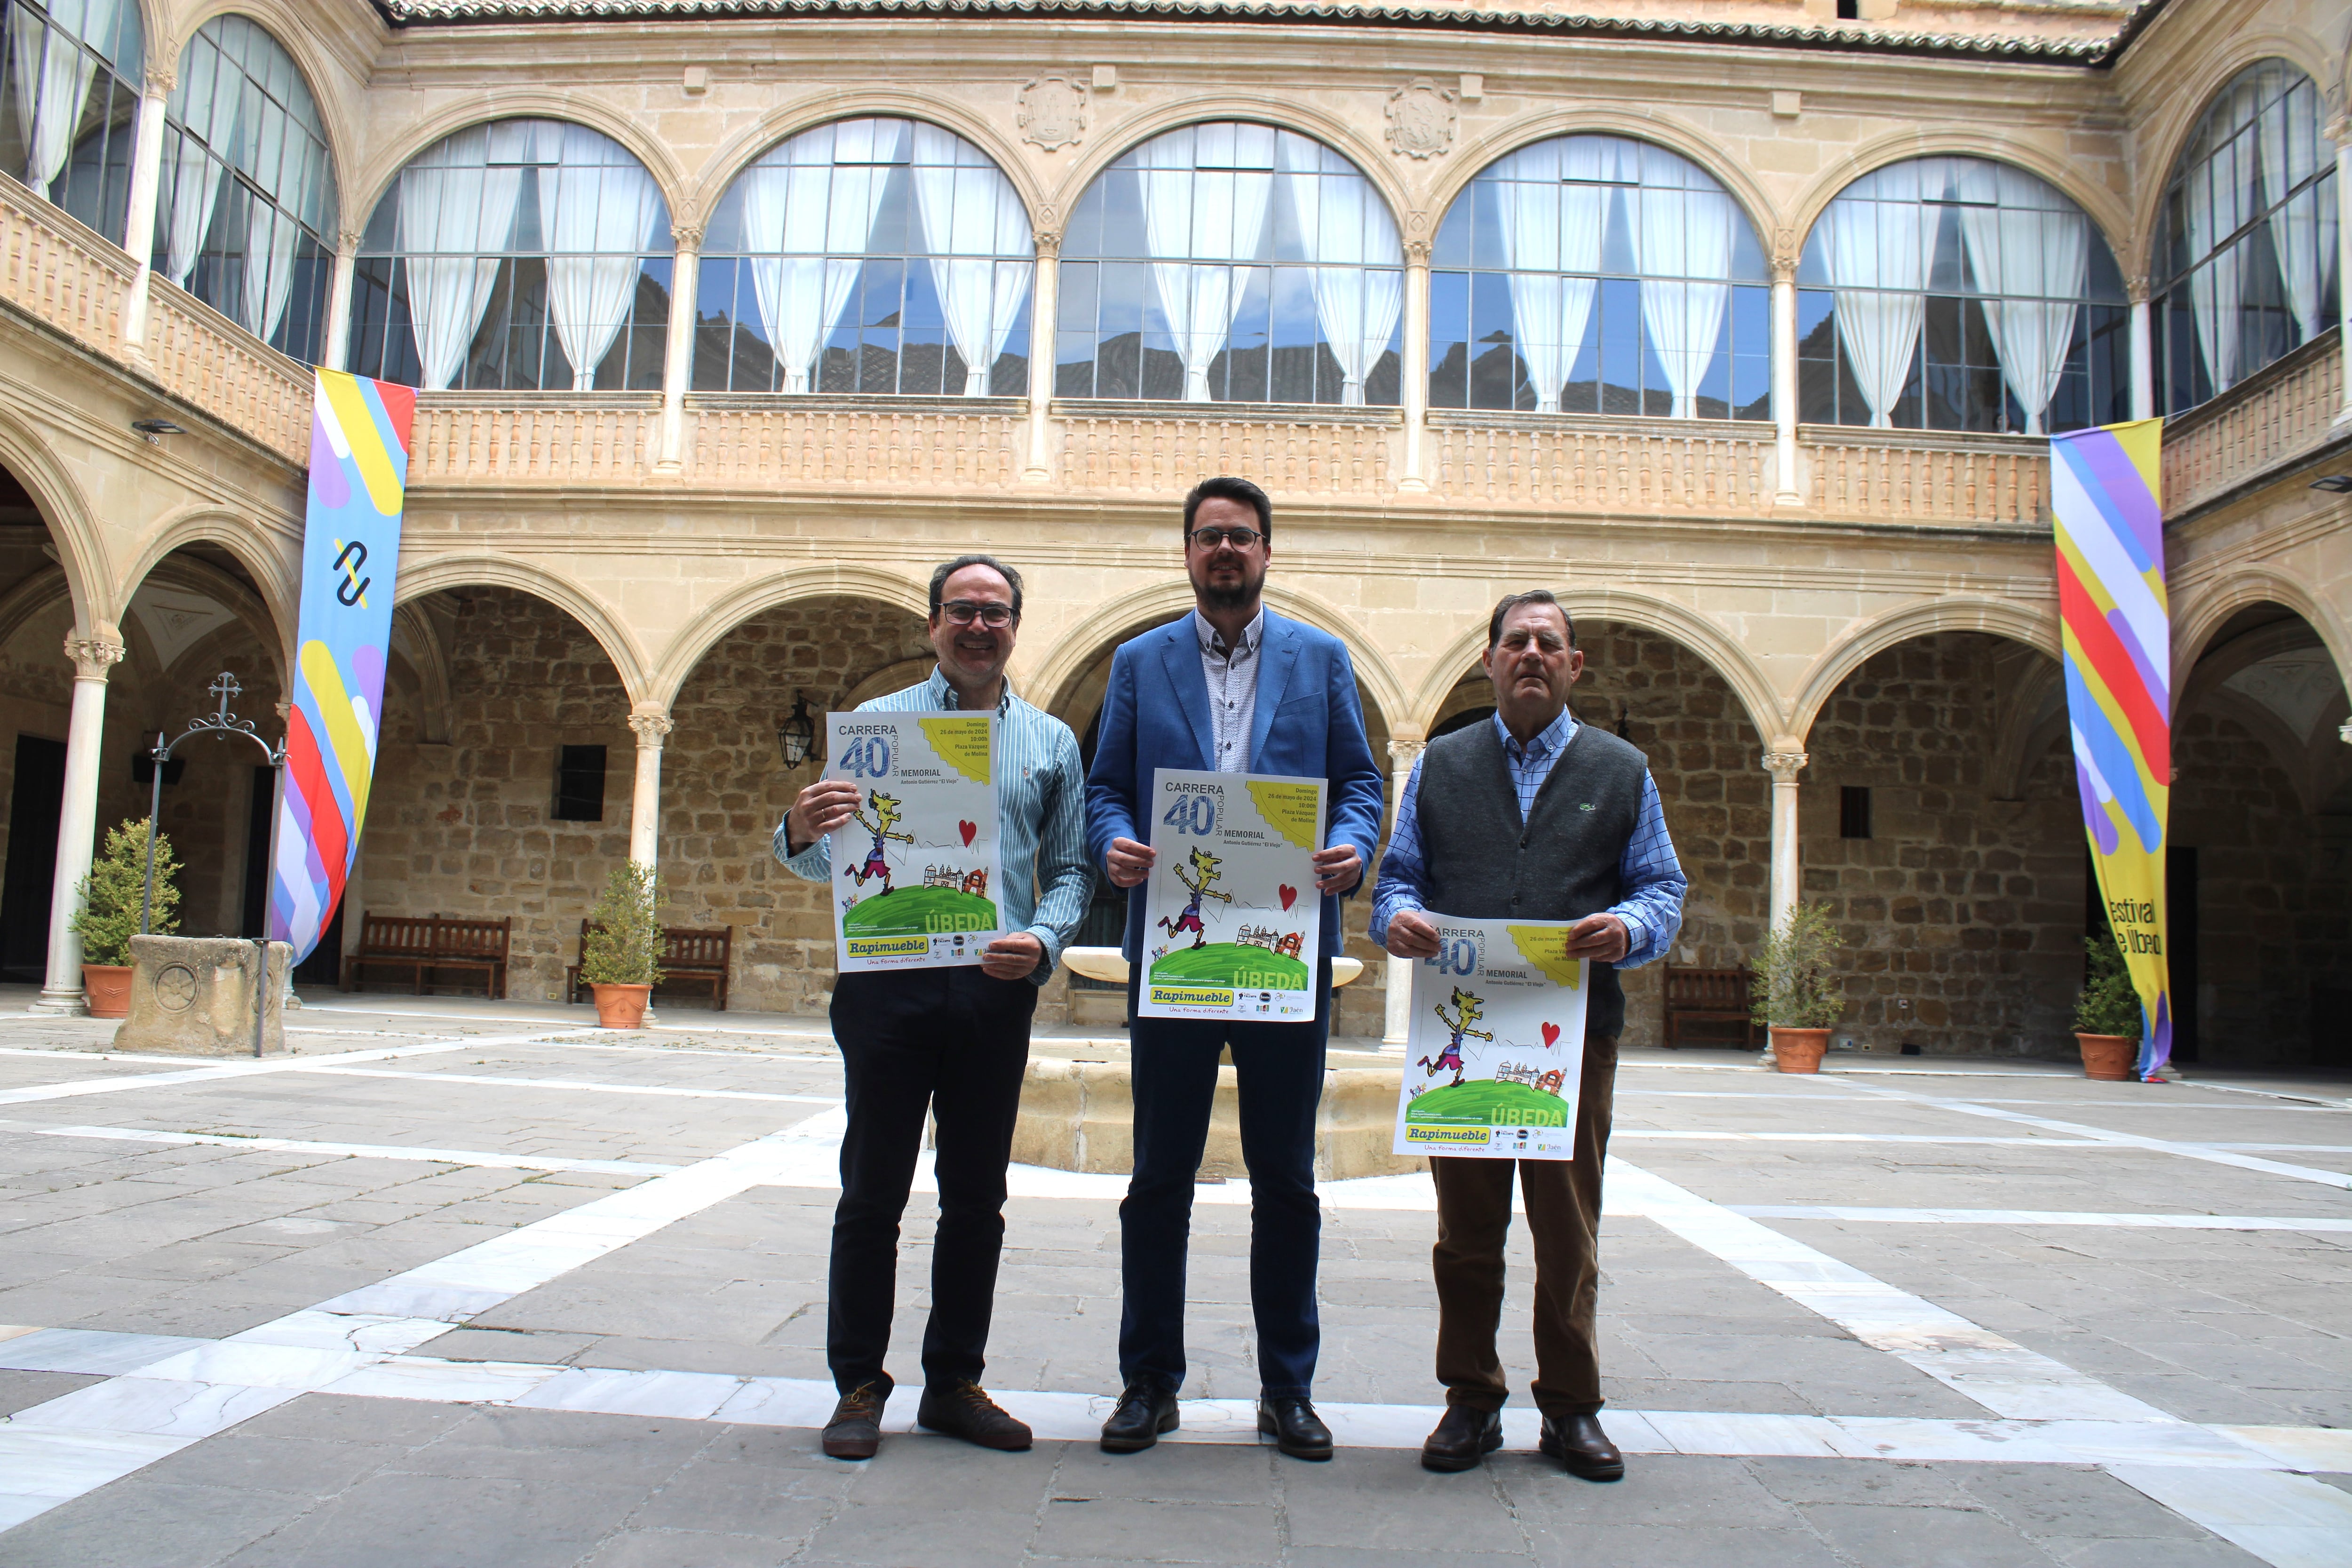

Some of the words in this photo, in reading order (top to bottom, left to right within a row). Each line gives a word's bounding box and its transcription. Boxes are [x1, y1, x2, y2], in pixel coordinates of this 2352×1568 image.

[839, 725, 897, 735] CARRERA
[840, 737, 890, 778] 40
[1166, 782, 1224, 795] CARRERA
[1163, 795, 1215, 836] 40
[1216, 795, 1224, 836] POPULAR
[1224, 829, 1264, 839] MEMORIAL
[925, 908, 994, 933] ÚBEDA
[2110, 899, 2156, 923] estival
[850, 940, 925, 954] Rapimueble
[2117, 933, 2127, 953] e
[2127, 924, 2162, 955] Úbed
[1424, 938, 1476, 976] 40
[1233, 965, 1303, 990] ÚBEDA
[1486, 970, 1527, 979] MEMORIAL
[1153, 990, 1230, 1003] Rapimueble
[1491, 1103, 1563, 1127] ÚBEDA
[1409, 1129, 1486, 1140] Rapimueble
